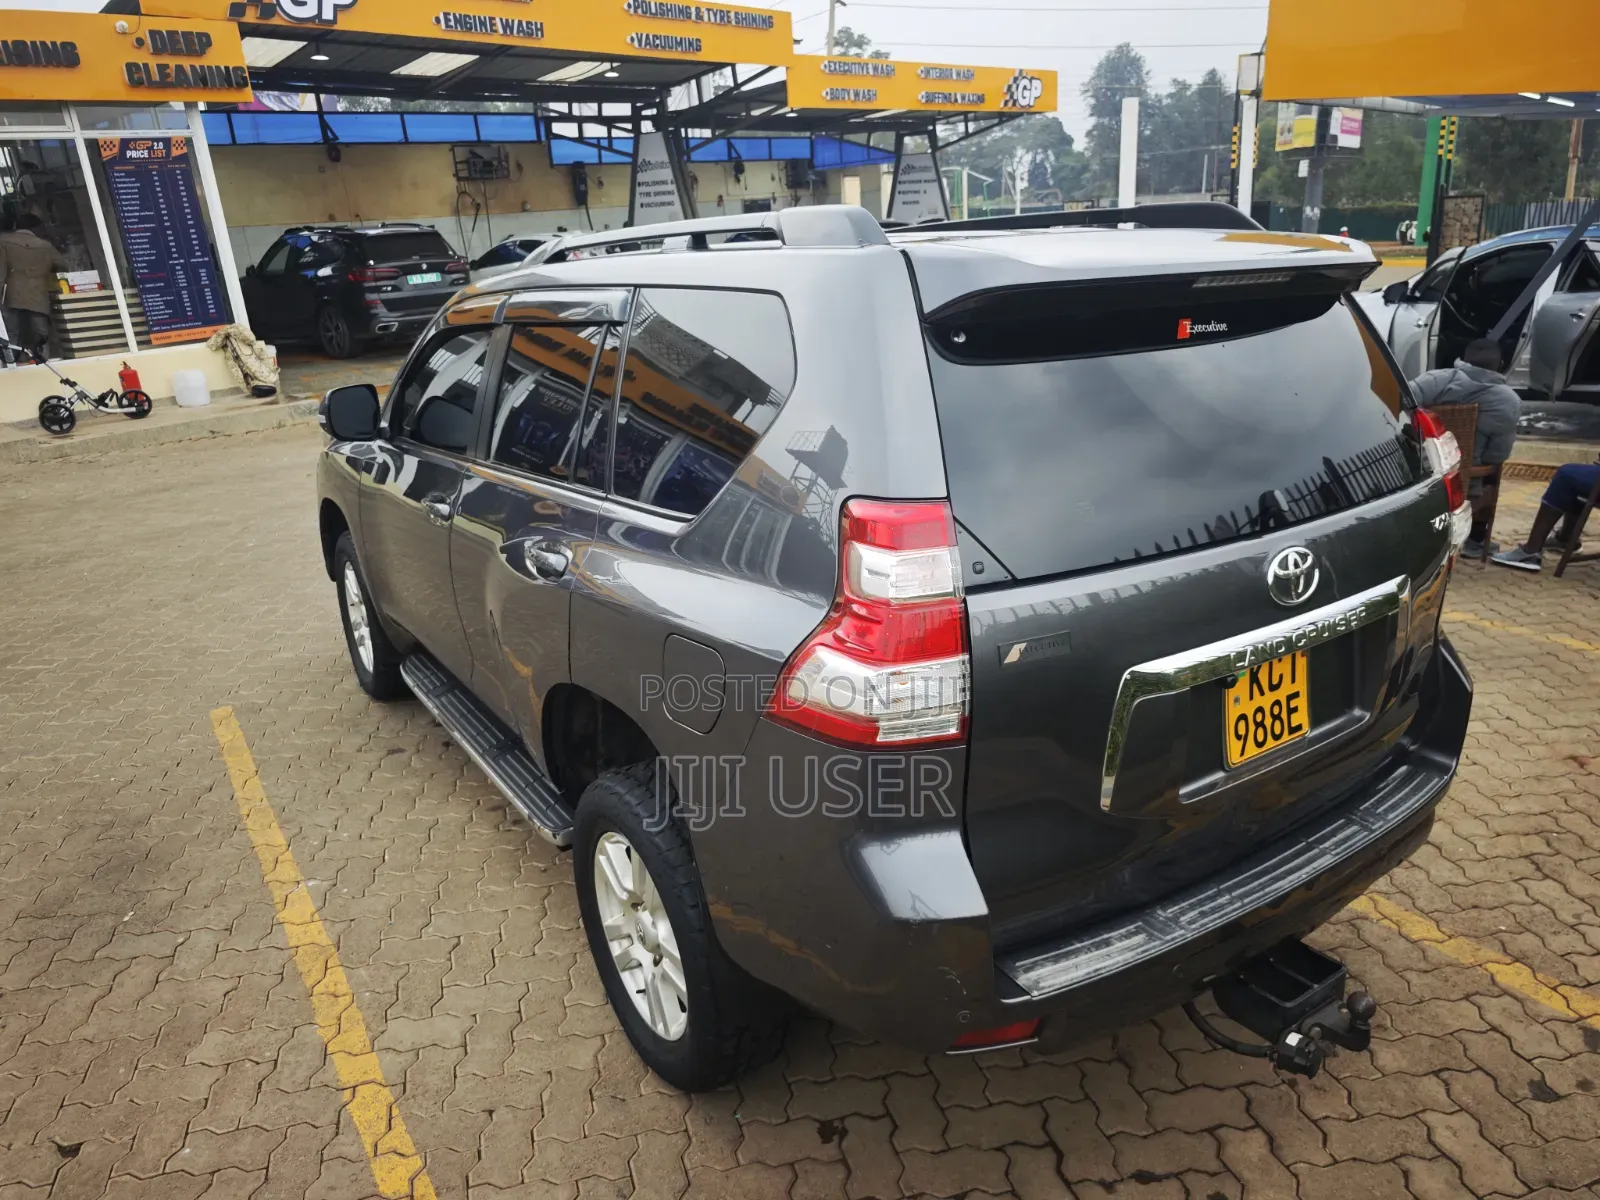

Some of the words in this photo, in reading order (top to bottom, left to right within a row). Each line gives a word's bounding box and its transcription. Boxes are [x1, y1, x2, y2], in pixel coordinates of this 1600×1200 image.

[441, 11, 498, 34] ENGINE
[499, 17, 544, 39] WASH
[632, 0, 692, 21] POLISHING
[693, 7, 704, 23] &
[704, 8, 731, 25] TYRE
[732, 11, 774, 30] SHINING
[146, 29, 212, 56] DEEP
[634, 32, 702, 53] VACUUMING
[123, 62, 249, 89] CLEANING
[827, 61, 870, 76] EXECUTIVE
[871, 63, 895, 77] WASH
[923, 67, 953, 79] INTERIOR
[954, 68, 974, 81] WASH
[829, 88, 851, 101] BODY
[852, 89, 877, 103] WASH
[959, 93, 985, 105] WAXING
[1017, 76, 1042, 108] GP
[126, 150, 149, 159] PRICE
[150, 149, 167, 158] LIST
[153, 141, 164, 150] 2.0
[1183, 320, 1228, 335] Executive
[1230, 637, 1286, 668] LAND
[1293, 606, 1366, 647] CRUISER
[1234, 690, 1303, 757] 988E
